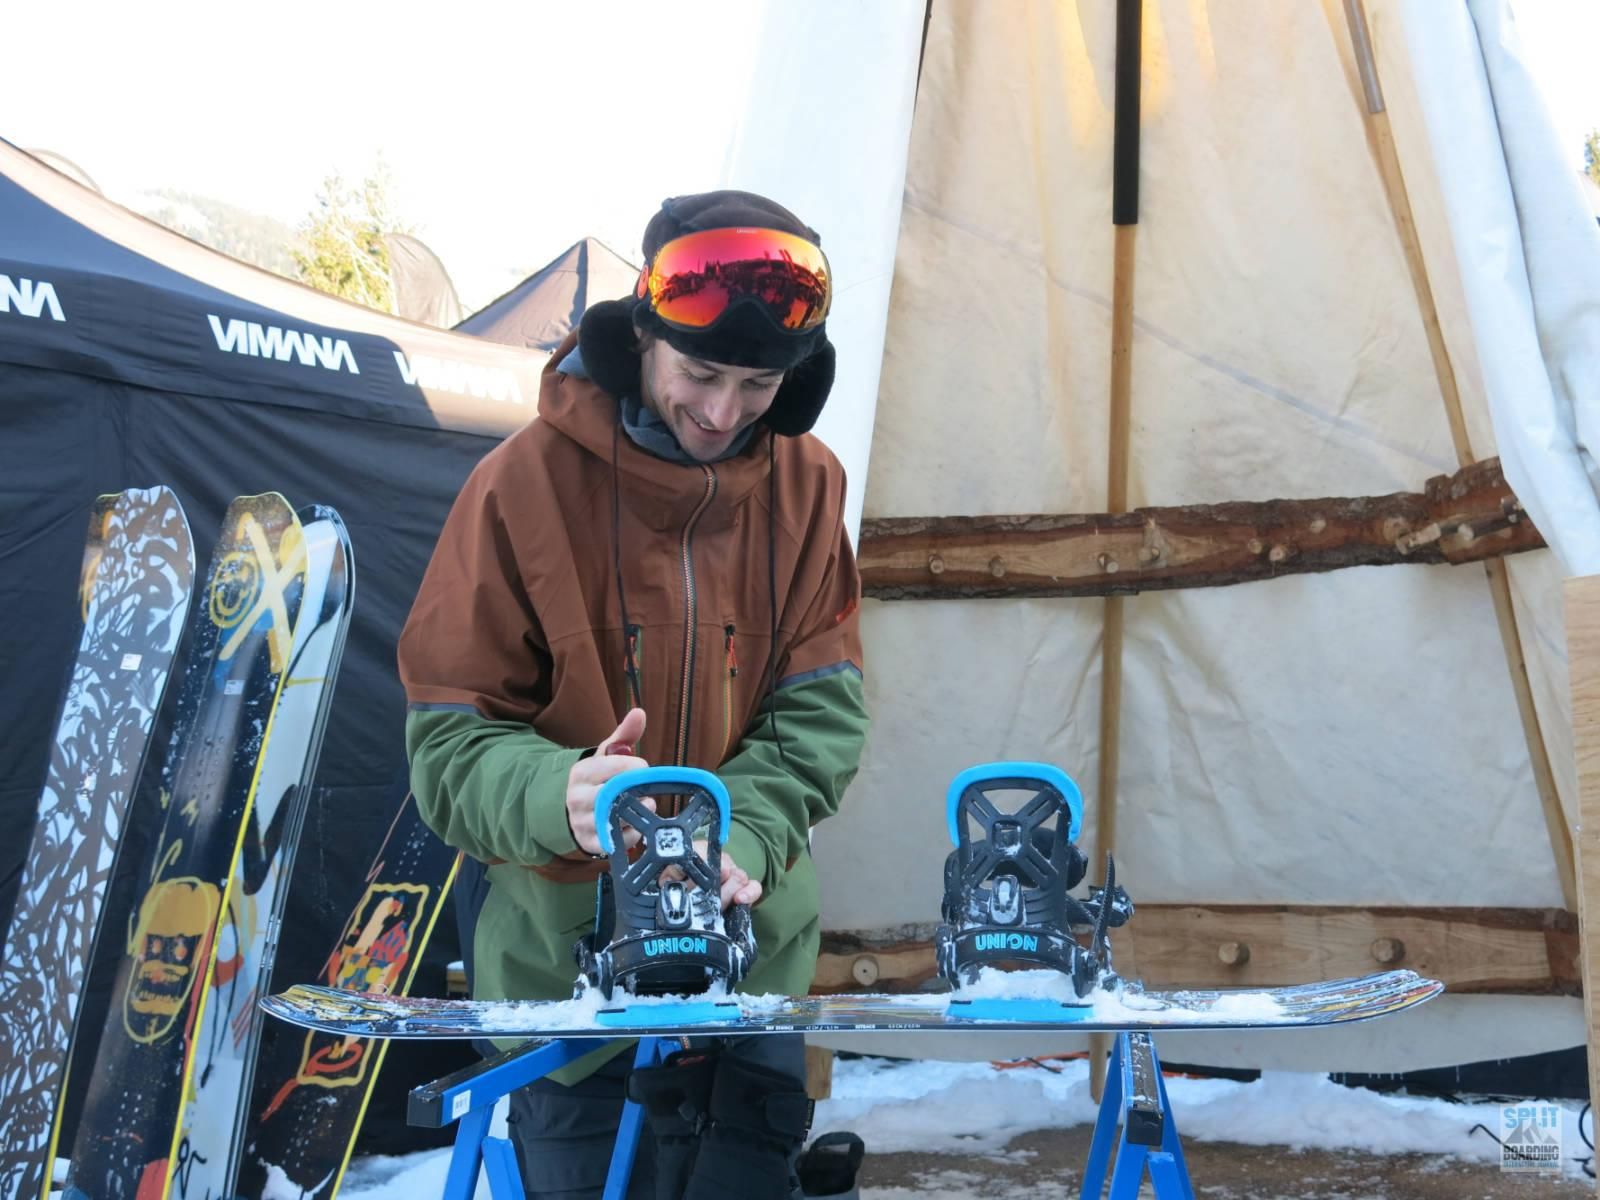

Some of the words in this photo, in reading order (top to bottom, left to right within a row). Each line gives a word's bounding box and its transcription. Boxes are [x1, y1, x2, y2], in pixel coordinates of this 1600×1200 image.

[207, 314, 360, 374] VIMANA
[643, 936, 707, 957] UNION
[975, 933, 1039, 953] UNION
